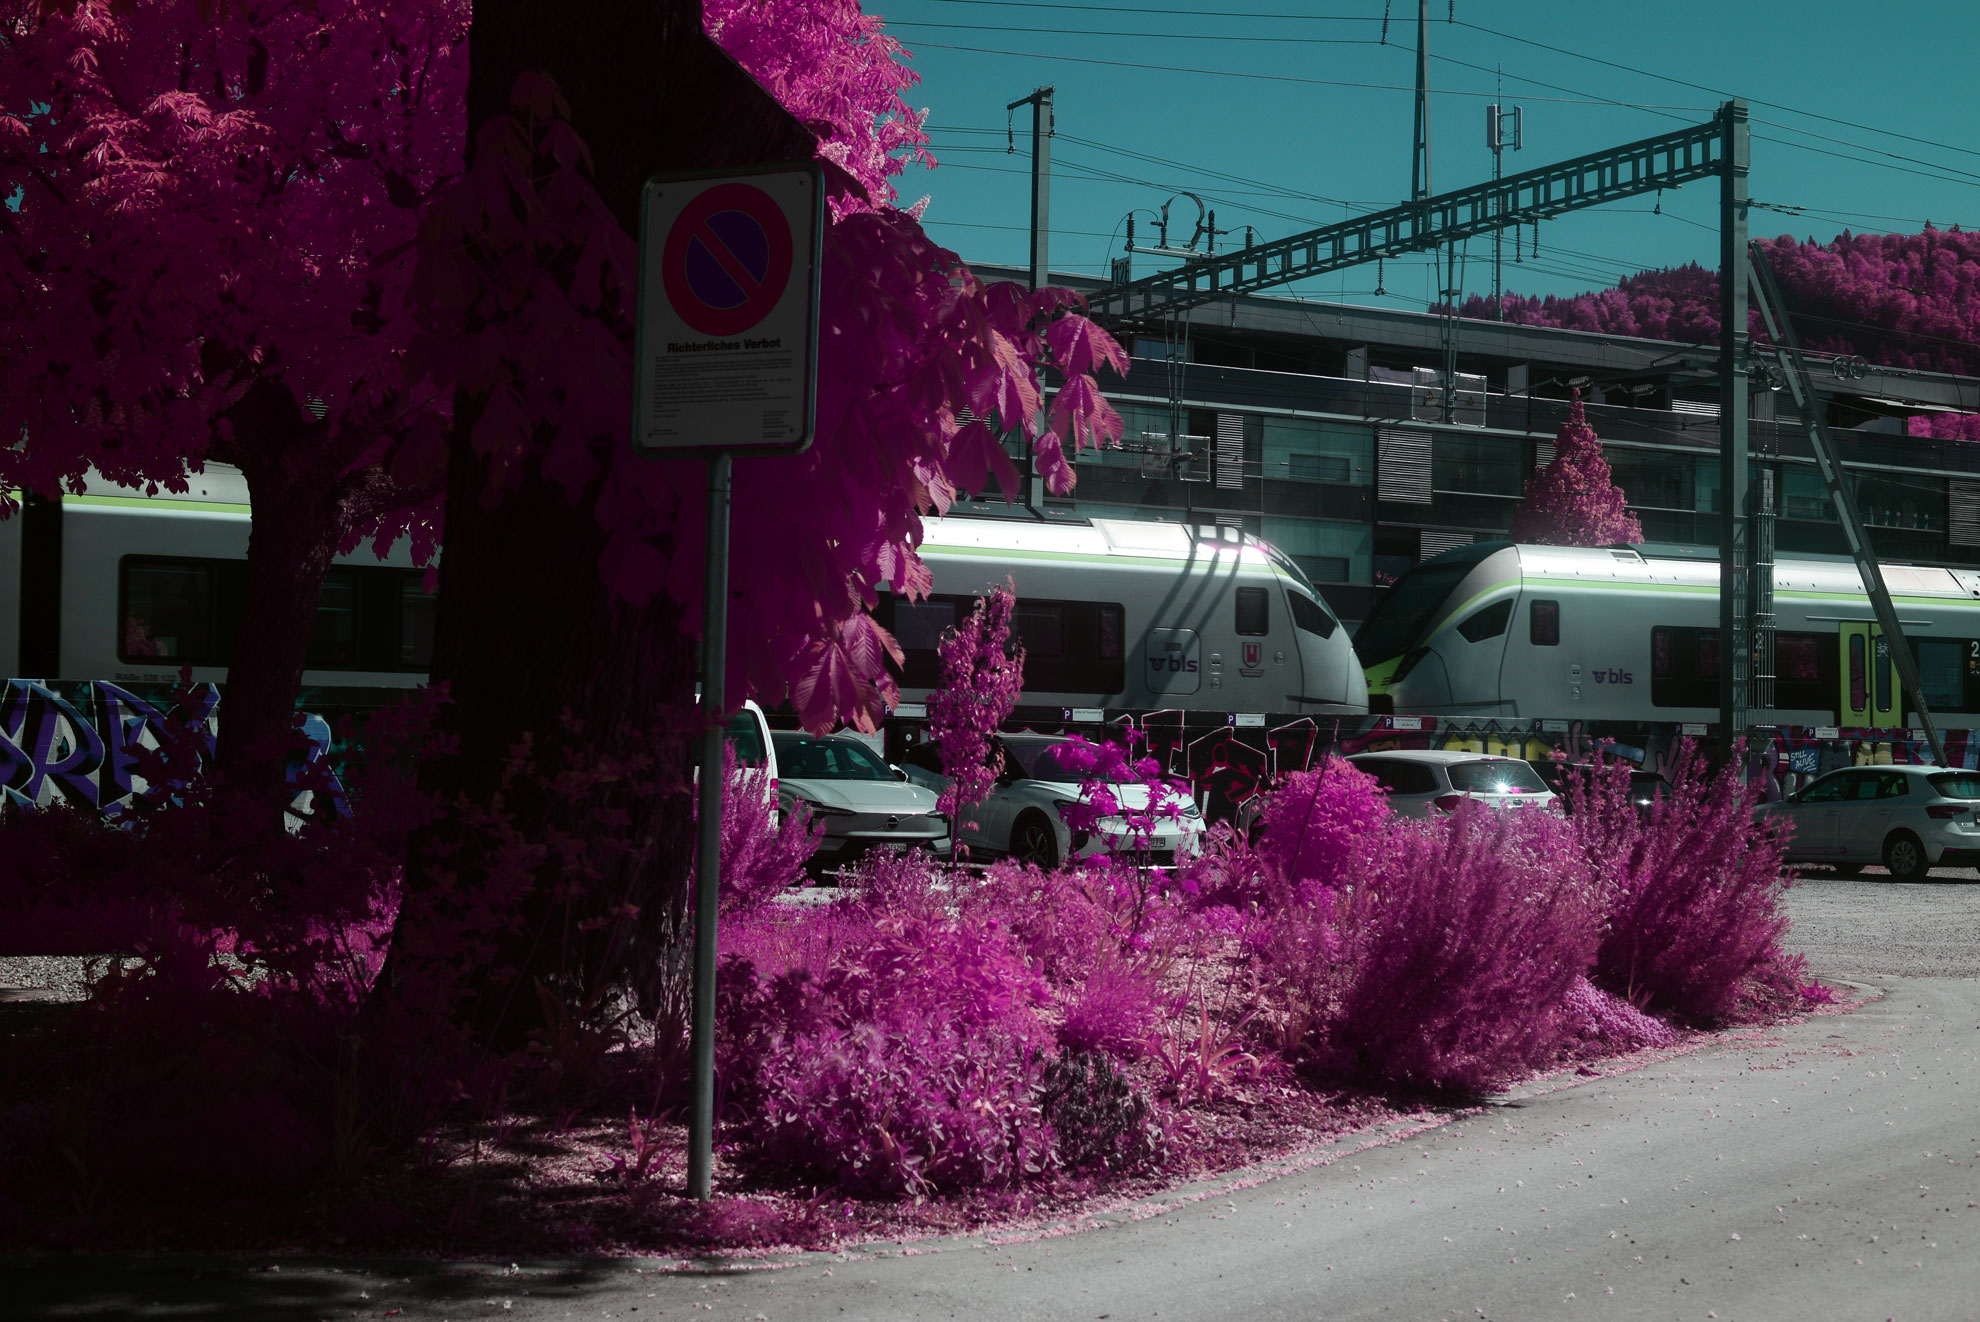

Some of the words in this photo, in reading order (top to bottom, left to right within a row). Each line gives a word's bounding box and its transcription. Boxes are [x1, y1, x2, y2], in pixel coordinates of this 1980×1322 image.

[667, 340, 740, 353] Richterliches
[743, 337, 781, 349] Verbot
[1971, 640, 1980, 658] 2
[1169, 654, 1198, 672] bls
[115, 673, 141, 681] RABe
[143, 674, 158, 682] 528
[1608, 668, 1633, 684] bls
[885, 705, 891, 714] P
[1064, 710, 1070, 719] P
[1228, 715, 1234, 724] P
[1386, 718, 1392, 727] P
[1535, 721, 1541, 730] P
[1790, 750, 1807, 761] STILL
[1795, 752, 1815, 769] ALIVE
